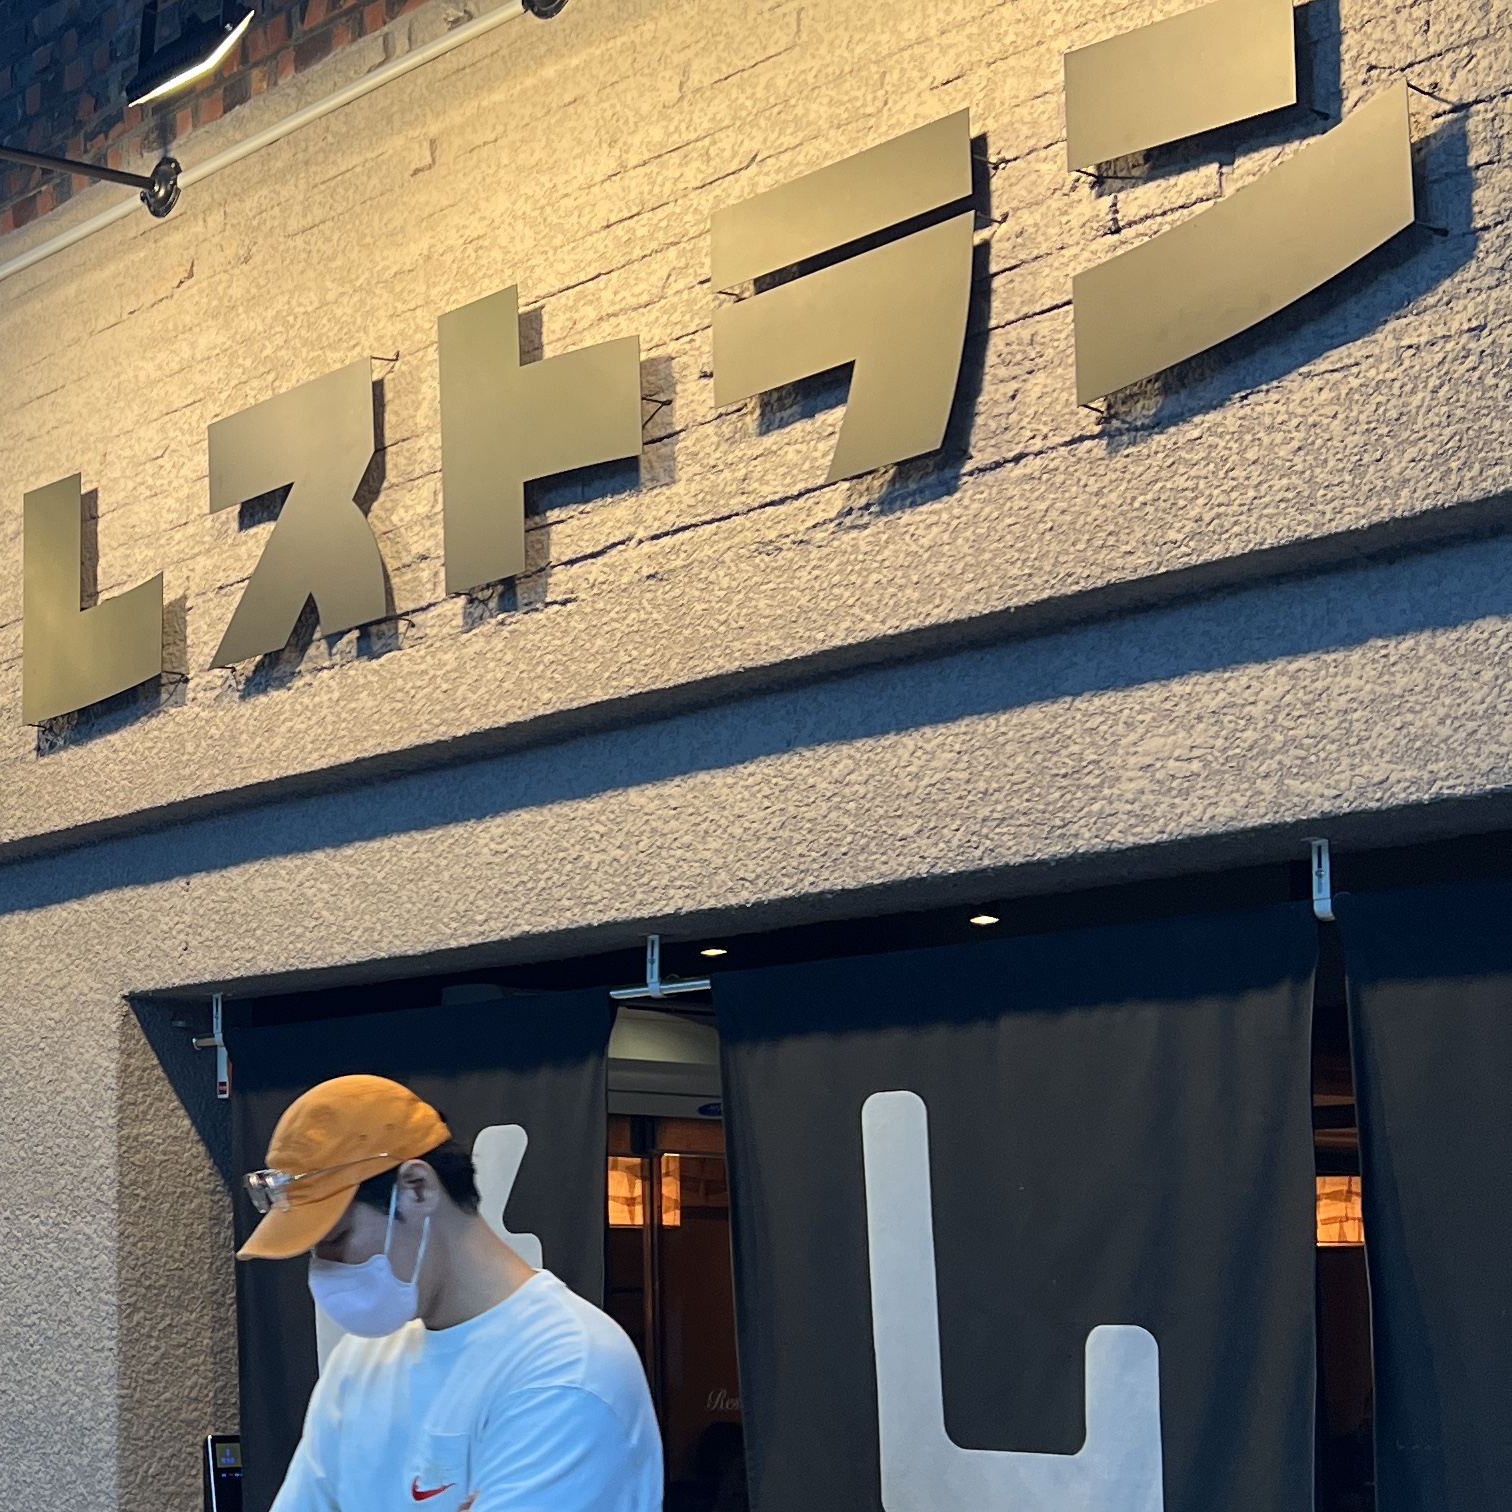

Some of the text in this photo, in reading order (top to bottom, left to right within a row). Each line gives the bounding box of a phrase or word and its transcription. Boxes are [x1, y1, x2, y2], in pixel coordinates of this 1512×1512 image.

[22, 0, 1414, 726] レストラン
